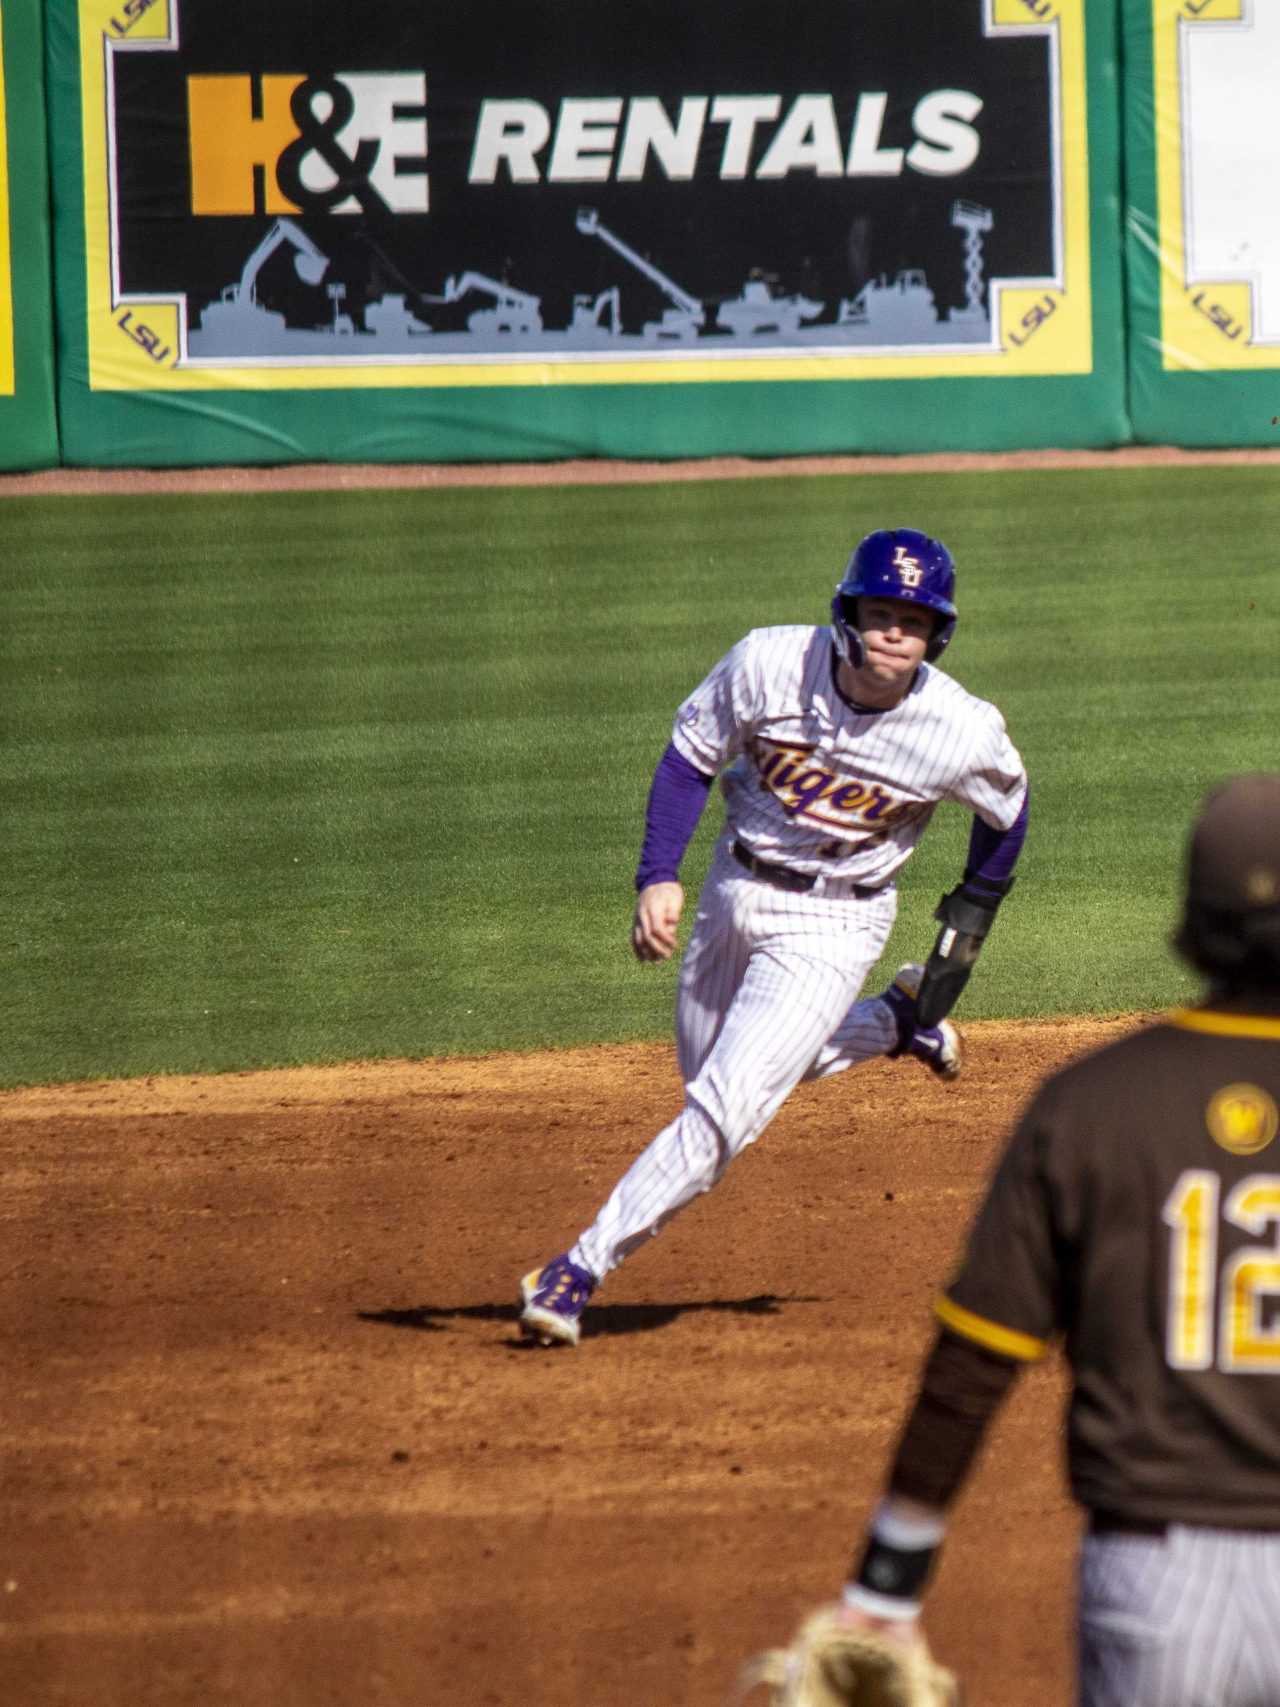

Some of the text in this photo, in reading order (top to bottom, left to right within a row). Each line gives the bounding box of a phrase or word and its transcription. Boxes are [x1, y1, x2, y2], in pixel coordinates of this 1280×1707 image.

[187, 70, 985, 216] H&E RENTALS
[893, 546, 924, 588] LSU
